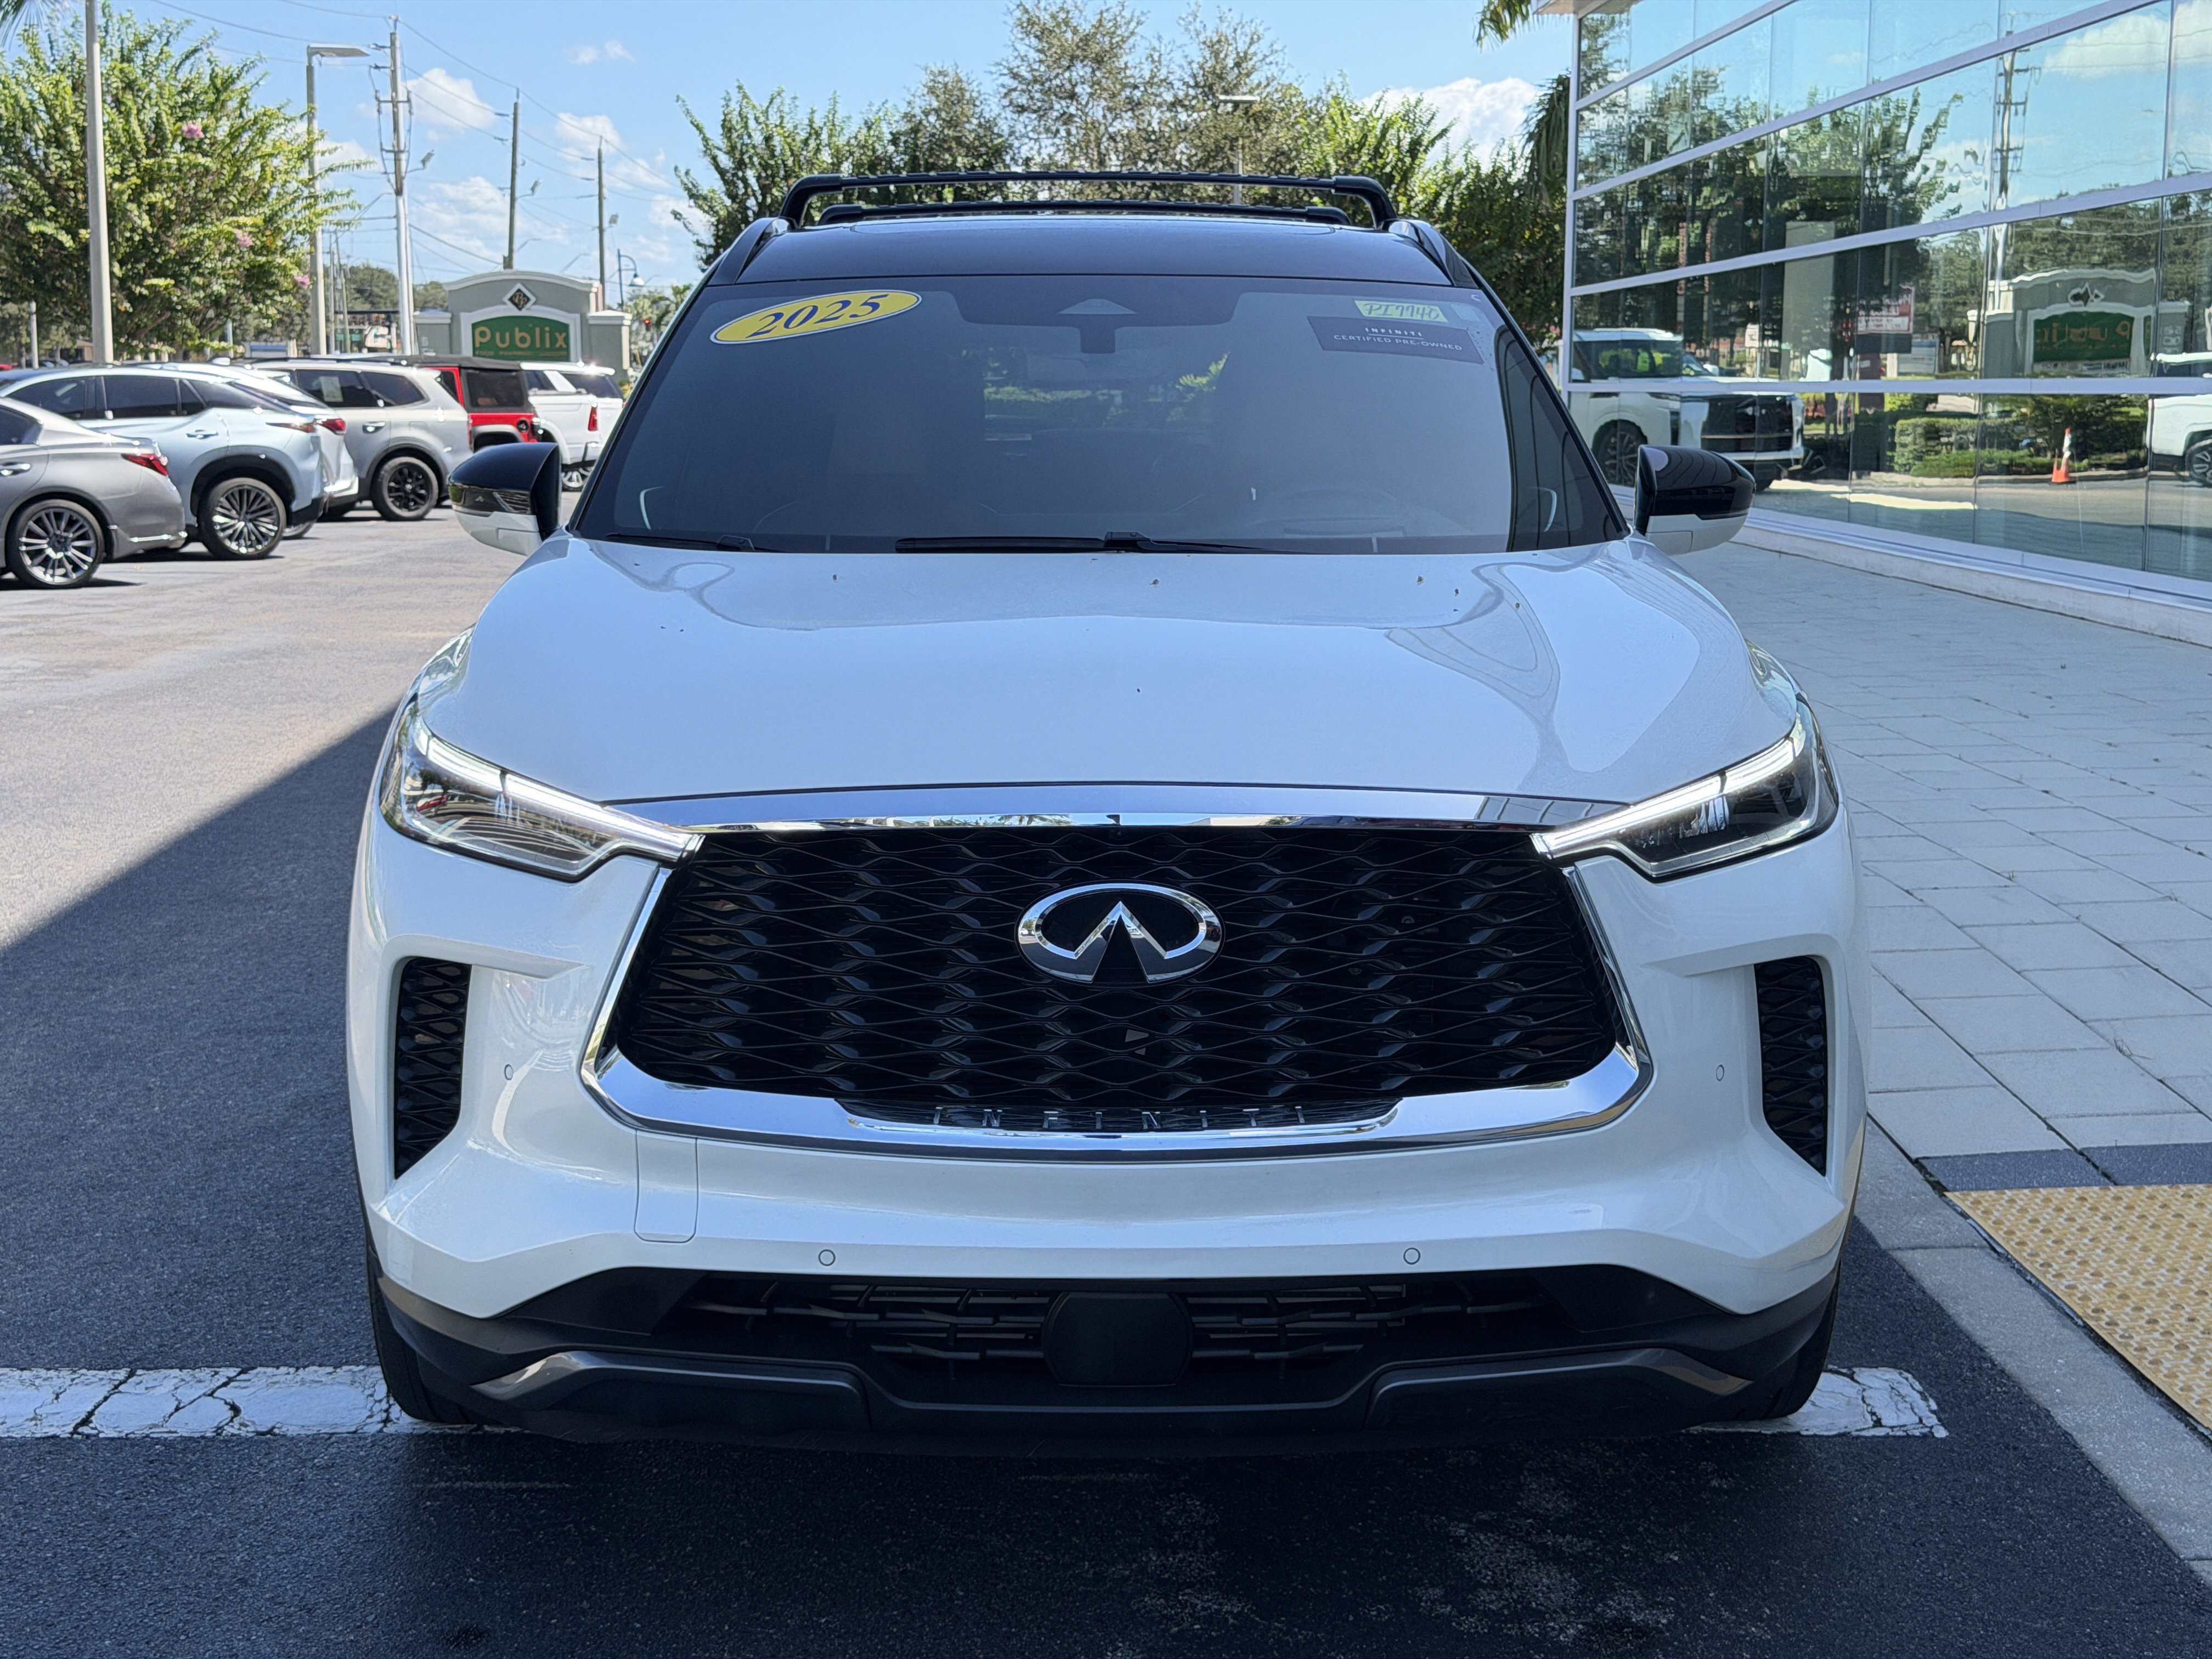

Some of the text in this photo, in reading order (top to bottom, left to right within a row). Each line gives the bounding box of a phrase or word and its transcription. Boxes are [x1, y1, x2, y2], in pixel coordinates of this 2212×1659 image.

[745, 294, 889, 338] 2025
[475, 326, 567, 348] Publix
[1334, 335, 1462, 351] CERTIFIED PRE-OWNED
[1364, 327, 1422, 337] INFINITI
[934, 1106, 1306, 1130] INFINITI
